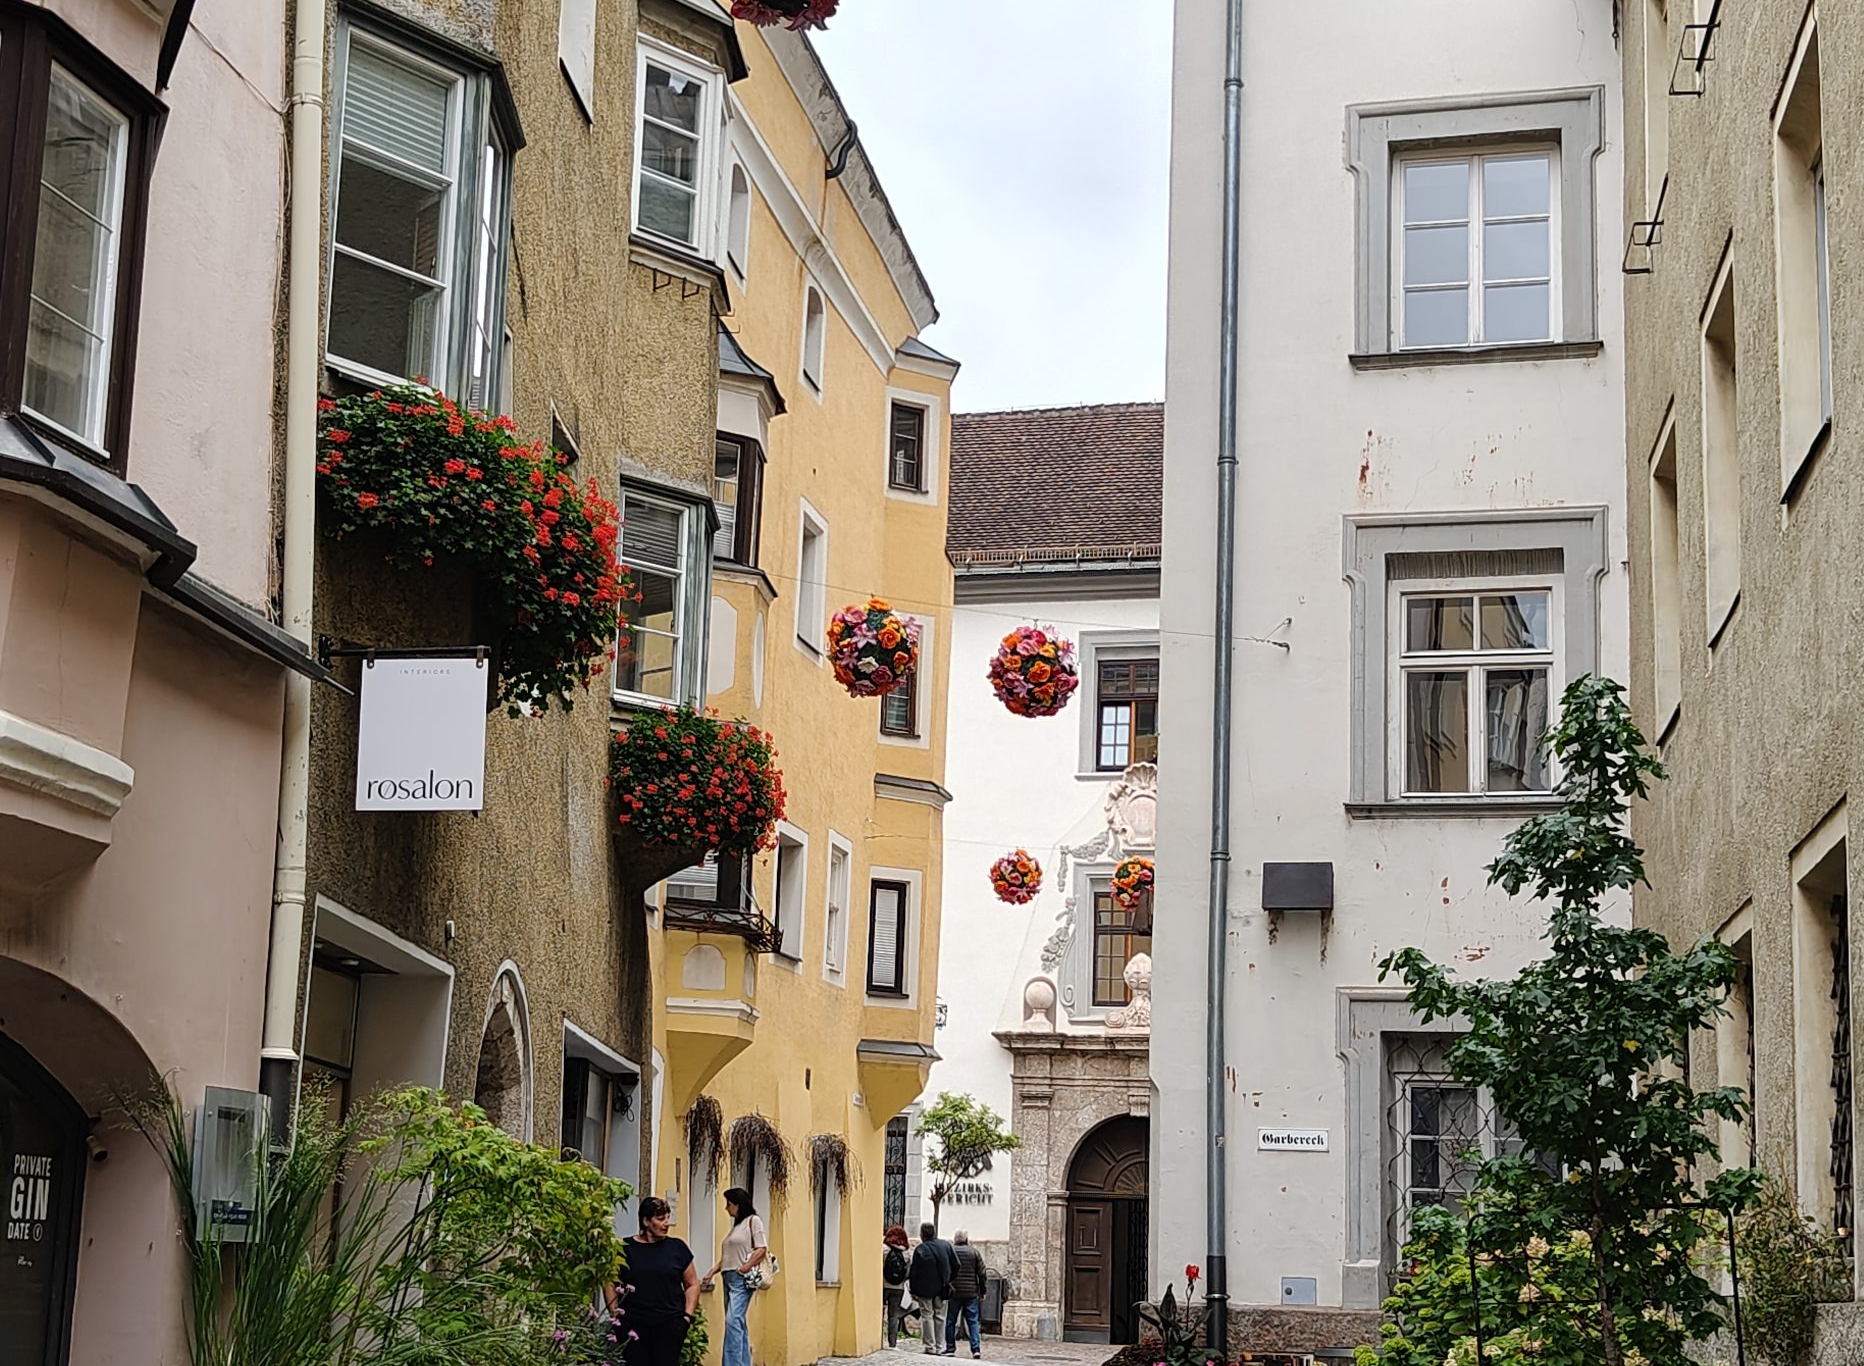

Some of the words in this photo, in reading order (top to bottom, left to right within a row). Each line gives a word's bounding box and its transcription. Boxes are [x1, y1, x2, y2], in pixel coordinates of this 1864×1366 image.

[1261, 1133, 1324, 1146] Garbereck
[14, 1154, 52, 1177] PRIVATE
[10, 1176, 50, 1221] GIN
[7, 1222, 31, 1240] DATE
